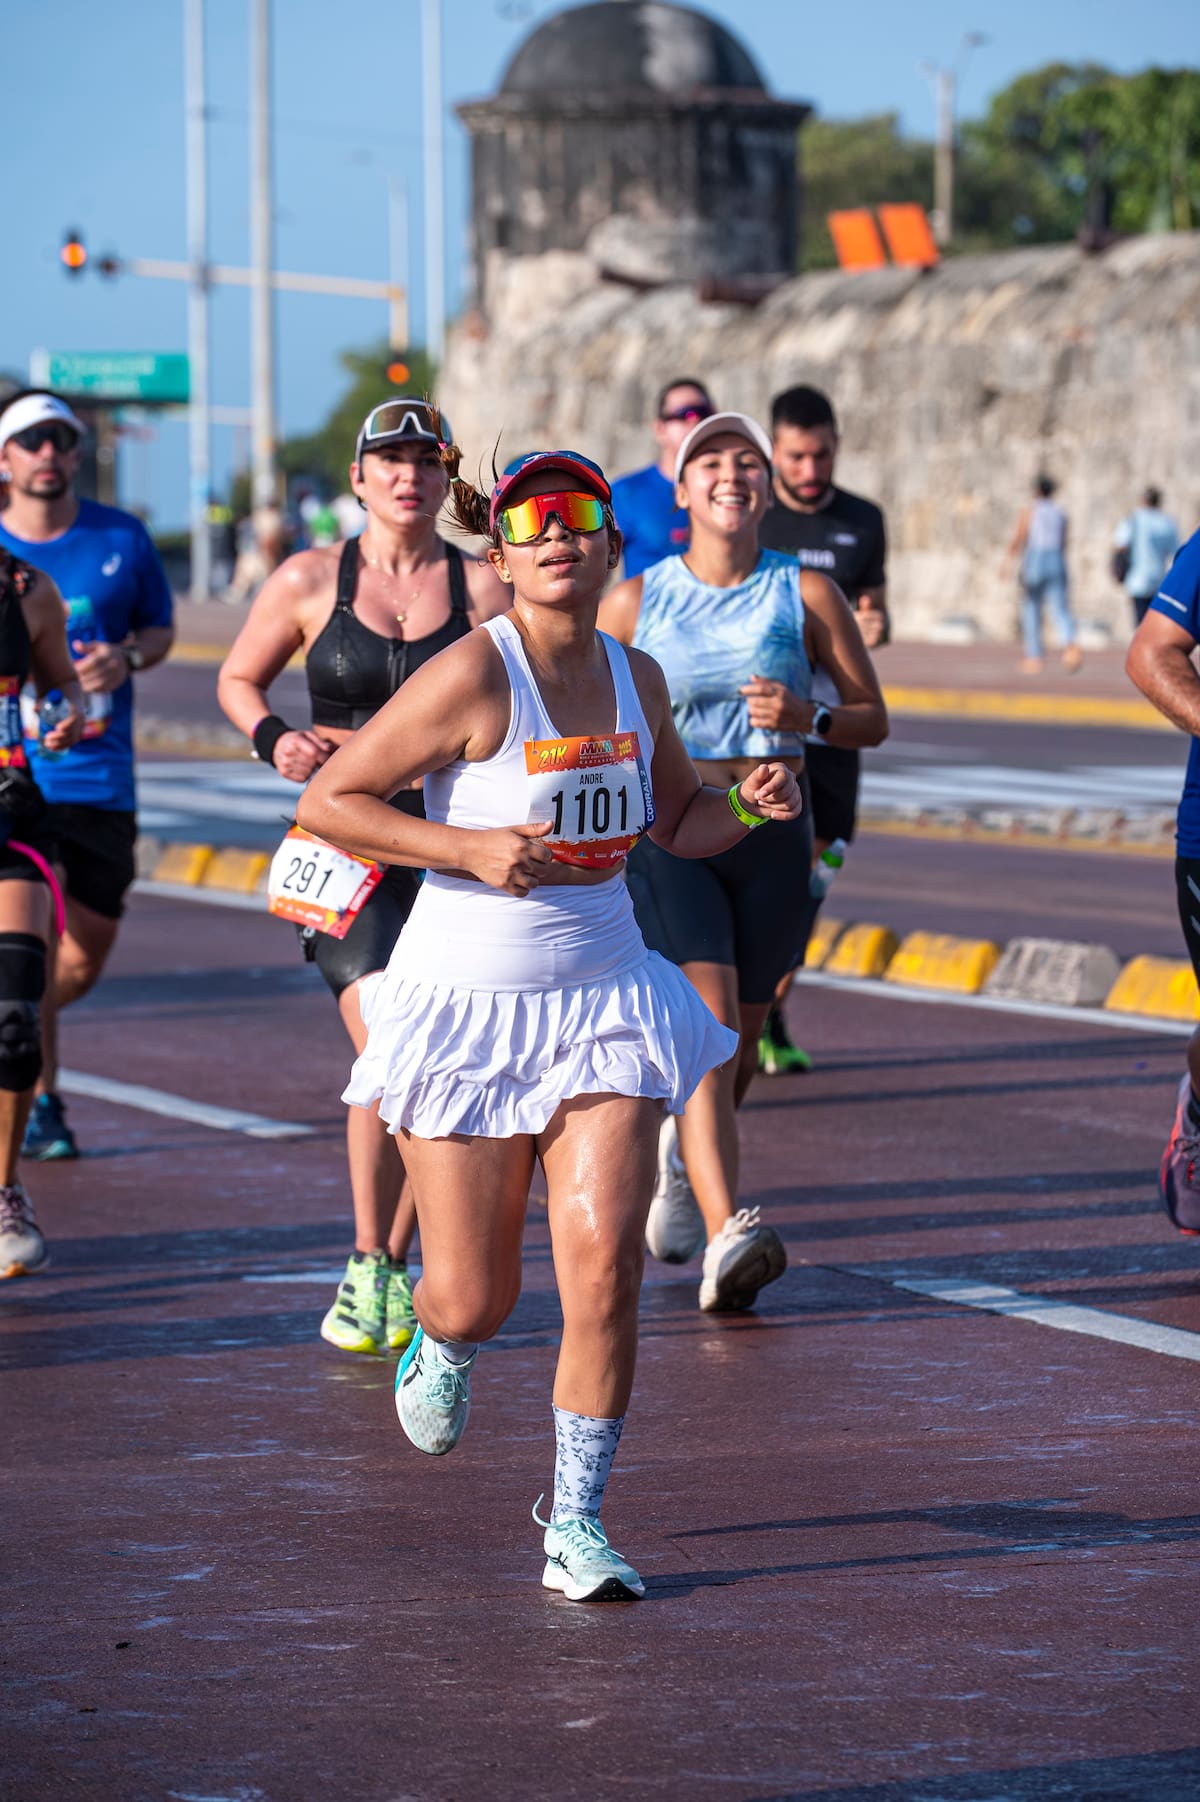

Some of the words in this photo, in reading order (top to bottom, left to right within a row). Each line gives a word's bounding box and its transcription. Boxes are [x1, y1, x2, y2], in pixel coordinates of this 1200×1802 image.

[539, 745, 568, 769] 21K
[579, 739, 614, 755] MMM
[579, 773, 604, 785] ANDRE
[552, 785, 627, 835] 1101
[643, 779, 654, 822] CORRAL
[283, 857, 334, 899] 291
